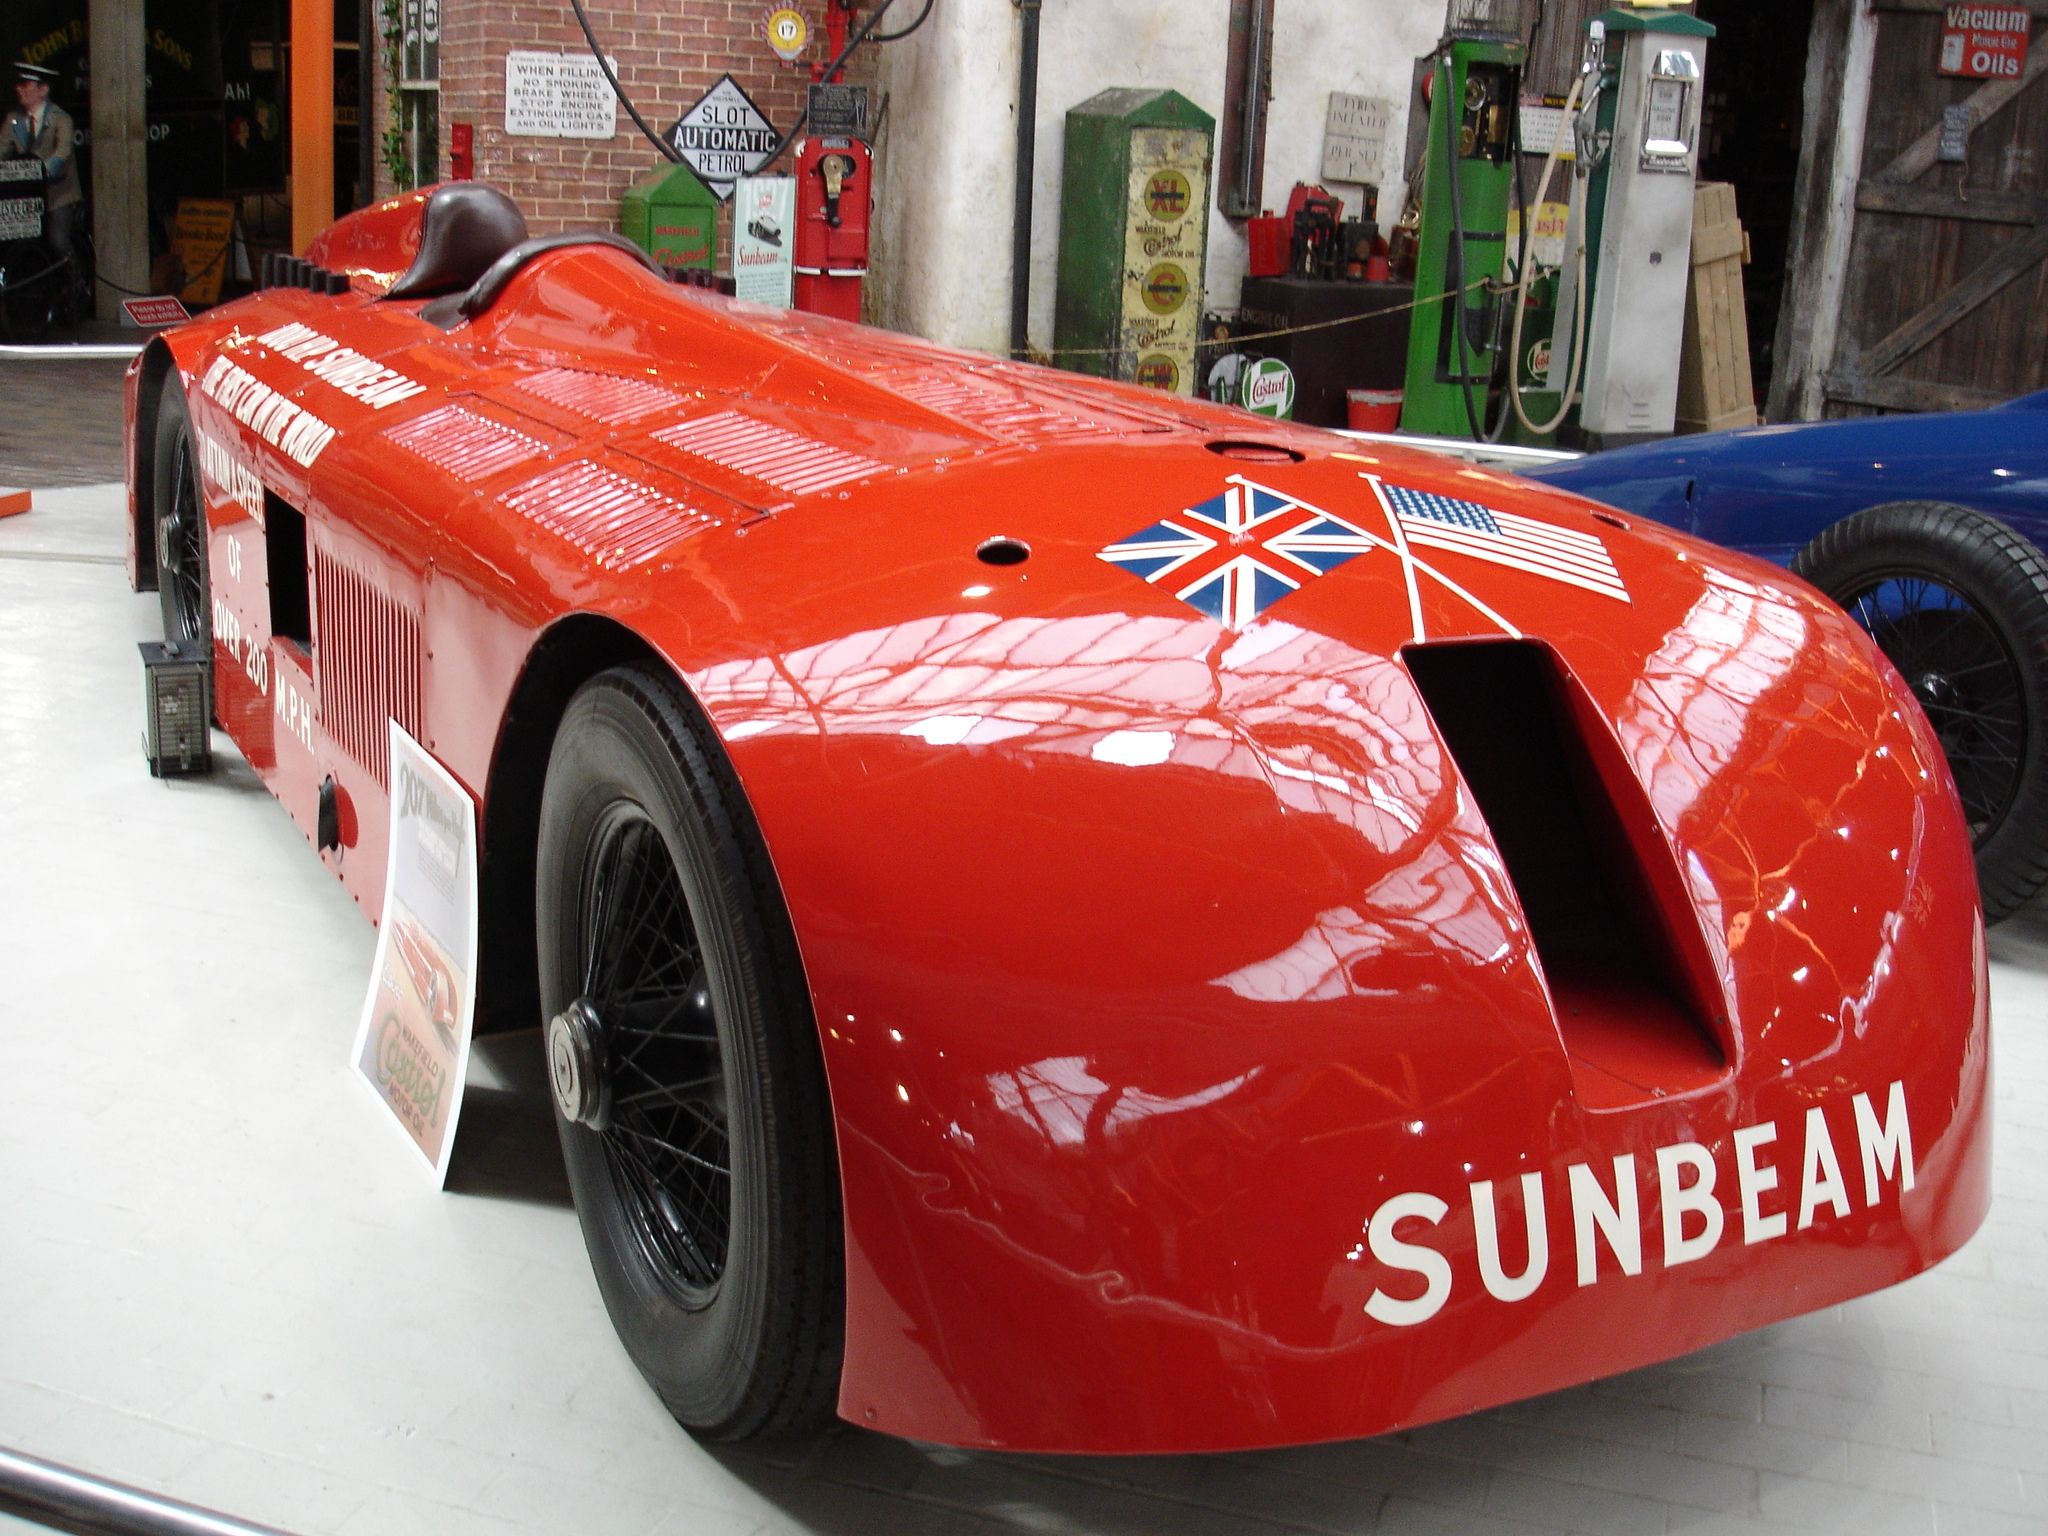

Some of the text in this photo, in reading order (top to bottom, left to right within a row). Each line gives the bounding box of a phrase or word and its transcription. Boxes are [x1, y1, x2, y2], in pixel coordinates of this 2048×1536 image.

[1947, 6, 2027, 32] Vacuum
[154, 28, 193, 70] SONS
[1971, 51, 2019, 75] Oils
[517, 65, 554, 76] WHEN
[524, 79, 601, 90] NO SMOKING
[514, 88, 609, 100] BRAKE WHEELS
[520, 99, 603, 110] STOP ENGINE
[510, 109, 611, 121] EXTINGUISH GAS
[539, 120, 555, 129] OIL
[561, 121, 604, 131] LIGHTS
[702, 105, 750, 126] SLOT
[674, 126, 776, 152] AUTOMATIC
[698, 152, 745, 173] PETROL
[1143, 224, 1183, 257] Castrol
[738, 244, 778, 267] Sunbeam
[1137, 319, 1176, 348] Castrol
[303, 347, 428, 410] SUNBEAM
[1252, 374, 1287, 405] Castrol
[237, 461, 265, 526] SPEED
[227, 534, 241, 583] OF
[214, 598, 315, 755] OVER 200 M.P.H.
[400, 761, 426, 818] 207
[402, 1023, 439, 1077] WAKEFIELD
[376, 1010, 446, 1129] Castrol
[389, 1083, 425, 1138] MOTOR OIL
[1363, 1079, 1915, 1327] SUNBEAM
